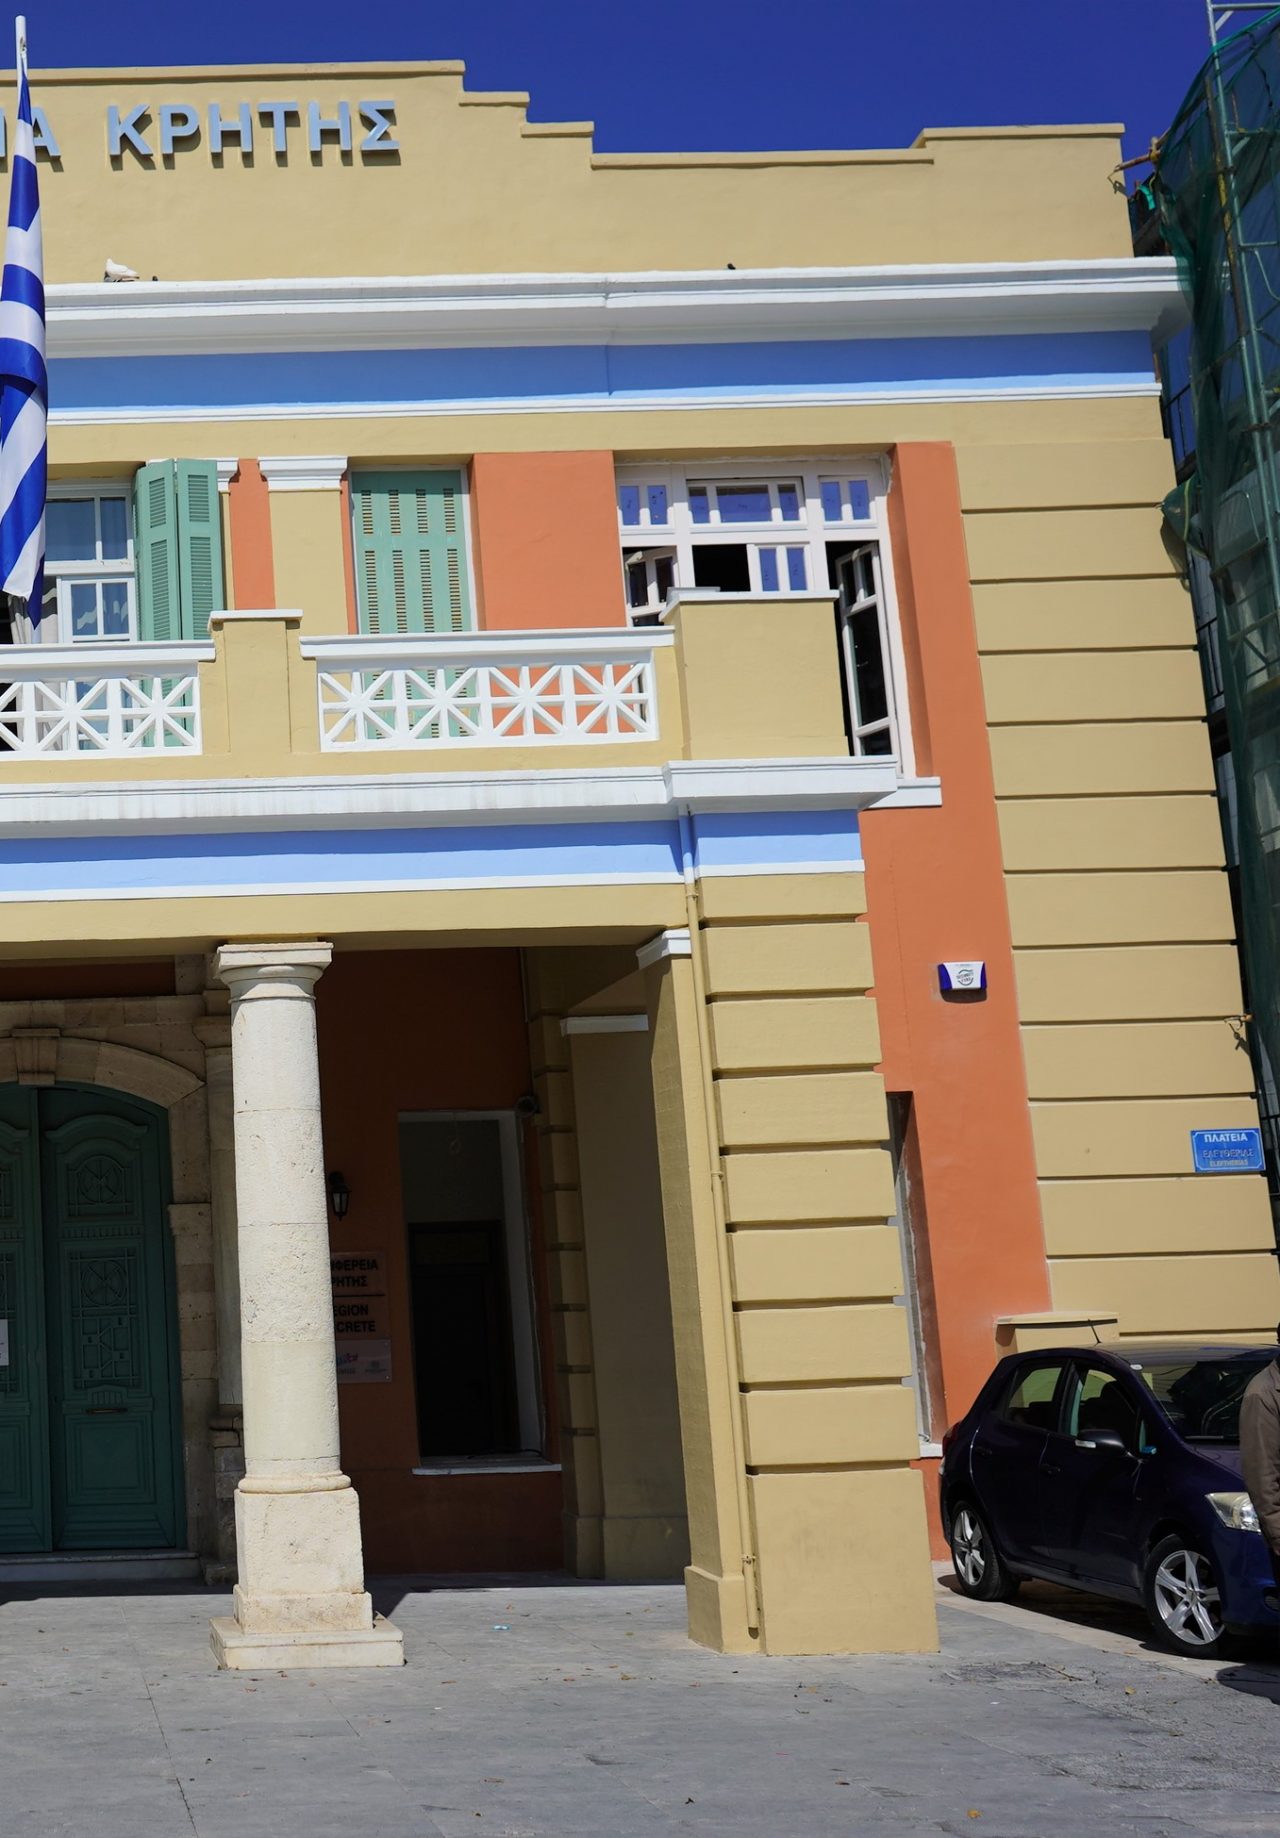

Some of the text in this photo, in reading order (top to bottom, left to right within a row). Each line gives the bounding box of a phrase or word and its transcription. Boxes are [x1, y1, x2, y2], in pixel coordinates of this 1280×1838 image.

[107, 100, 400, 156] ΚΡΗΤΗΣ
[1204, 1133, 1248, 1143] ΠΛΑΤΕΙΑ
[331, 1259, 378, 1271] ΙΦΕΡΕΙΑ
[332, 1276, 368, 1287] ΡΗΤΗΣ
[333, 1305, 368, 1316] EGION
[336, 1320, 376, 1333] CRETE
